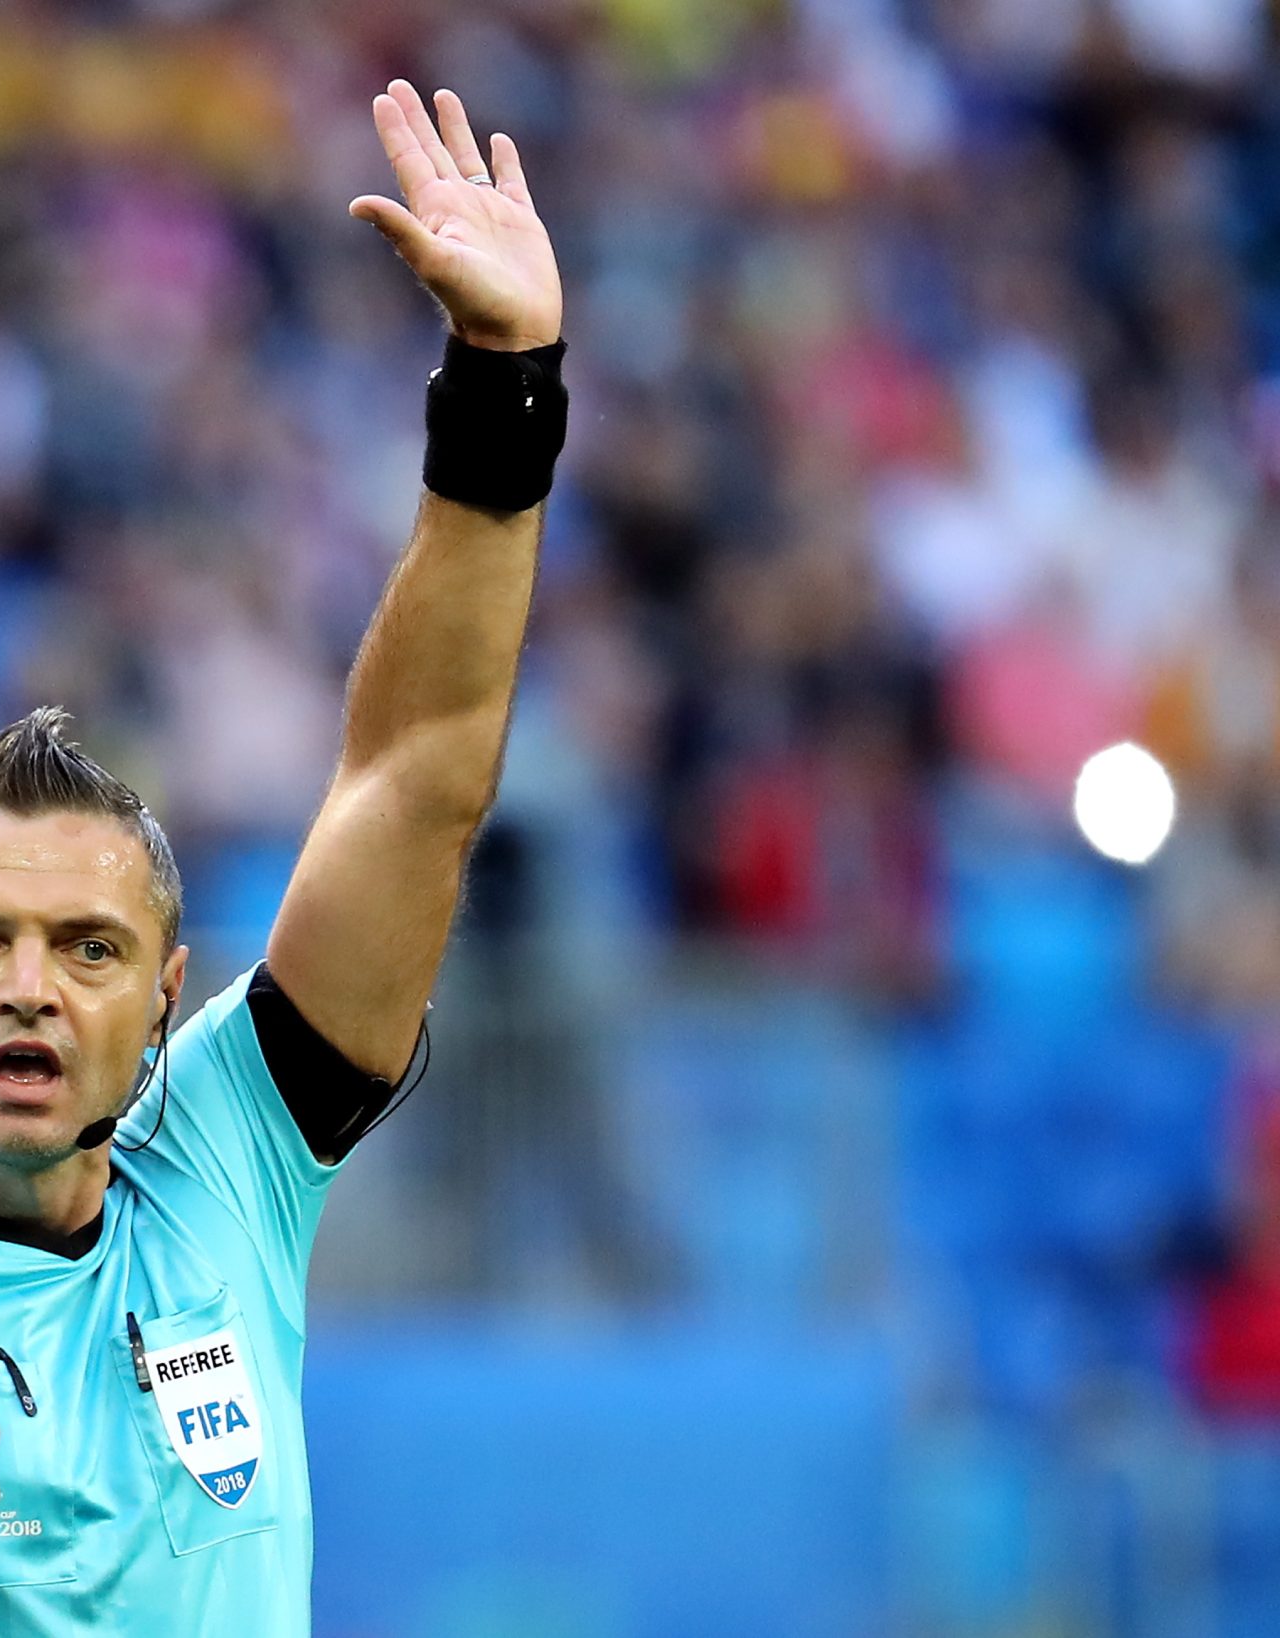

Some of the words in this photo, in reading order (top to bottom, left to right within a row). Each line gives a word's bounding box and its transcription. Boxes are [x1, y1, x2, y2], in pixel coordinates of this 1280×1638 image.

[156, 1344, 234, 1383] REFEREE
[177, 1400, 250, 1445] FIFA
[214, 1471, 247, 1495] 2018
[0, 1520, 42, 1537] 2018
